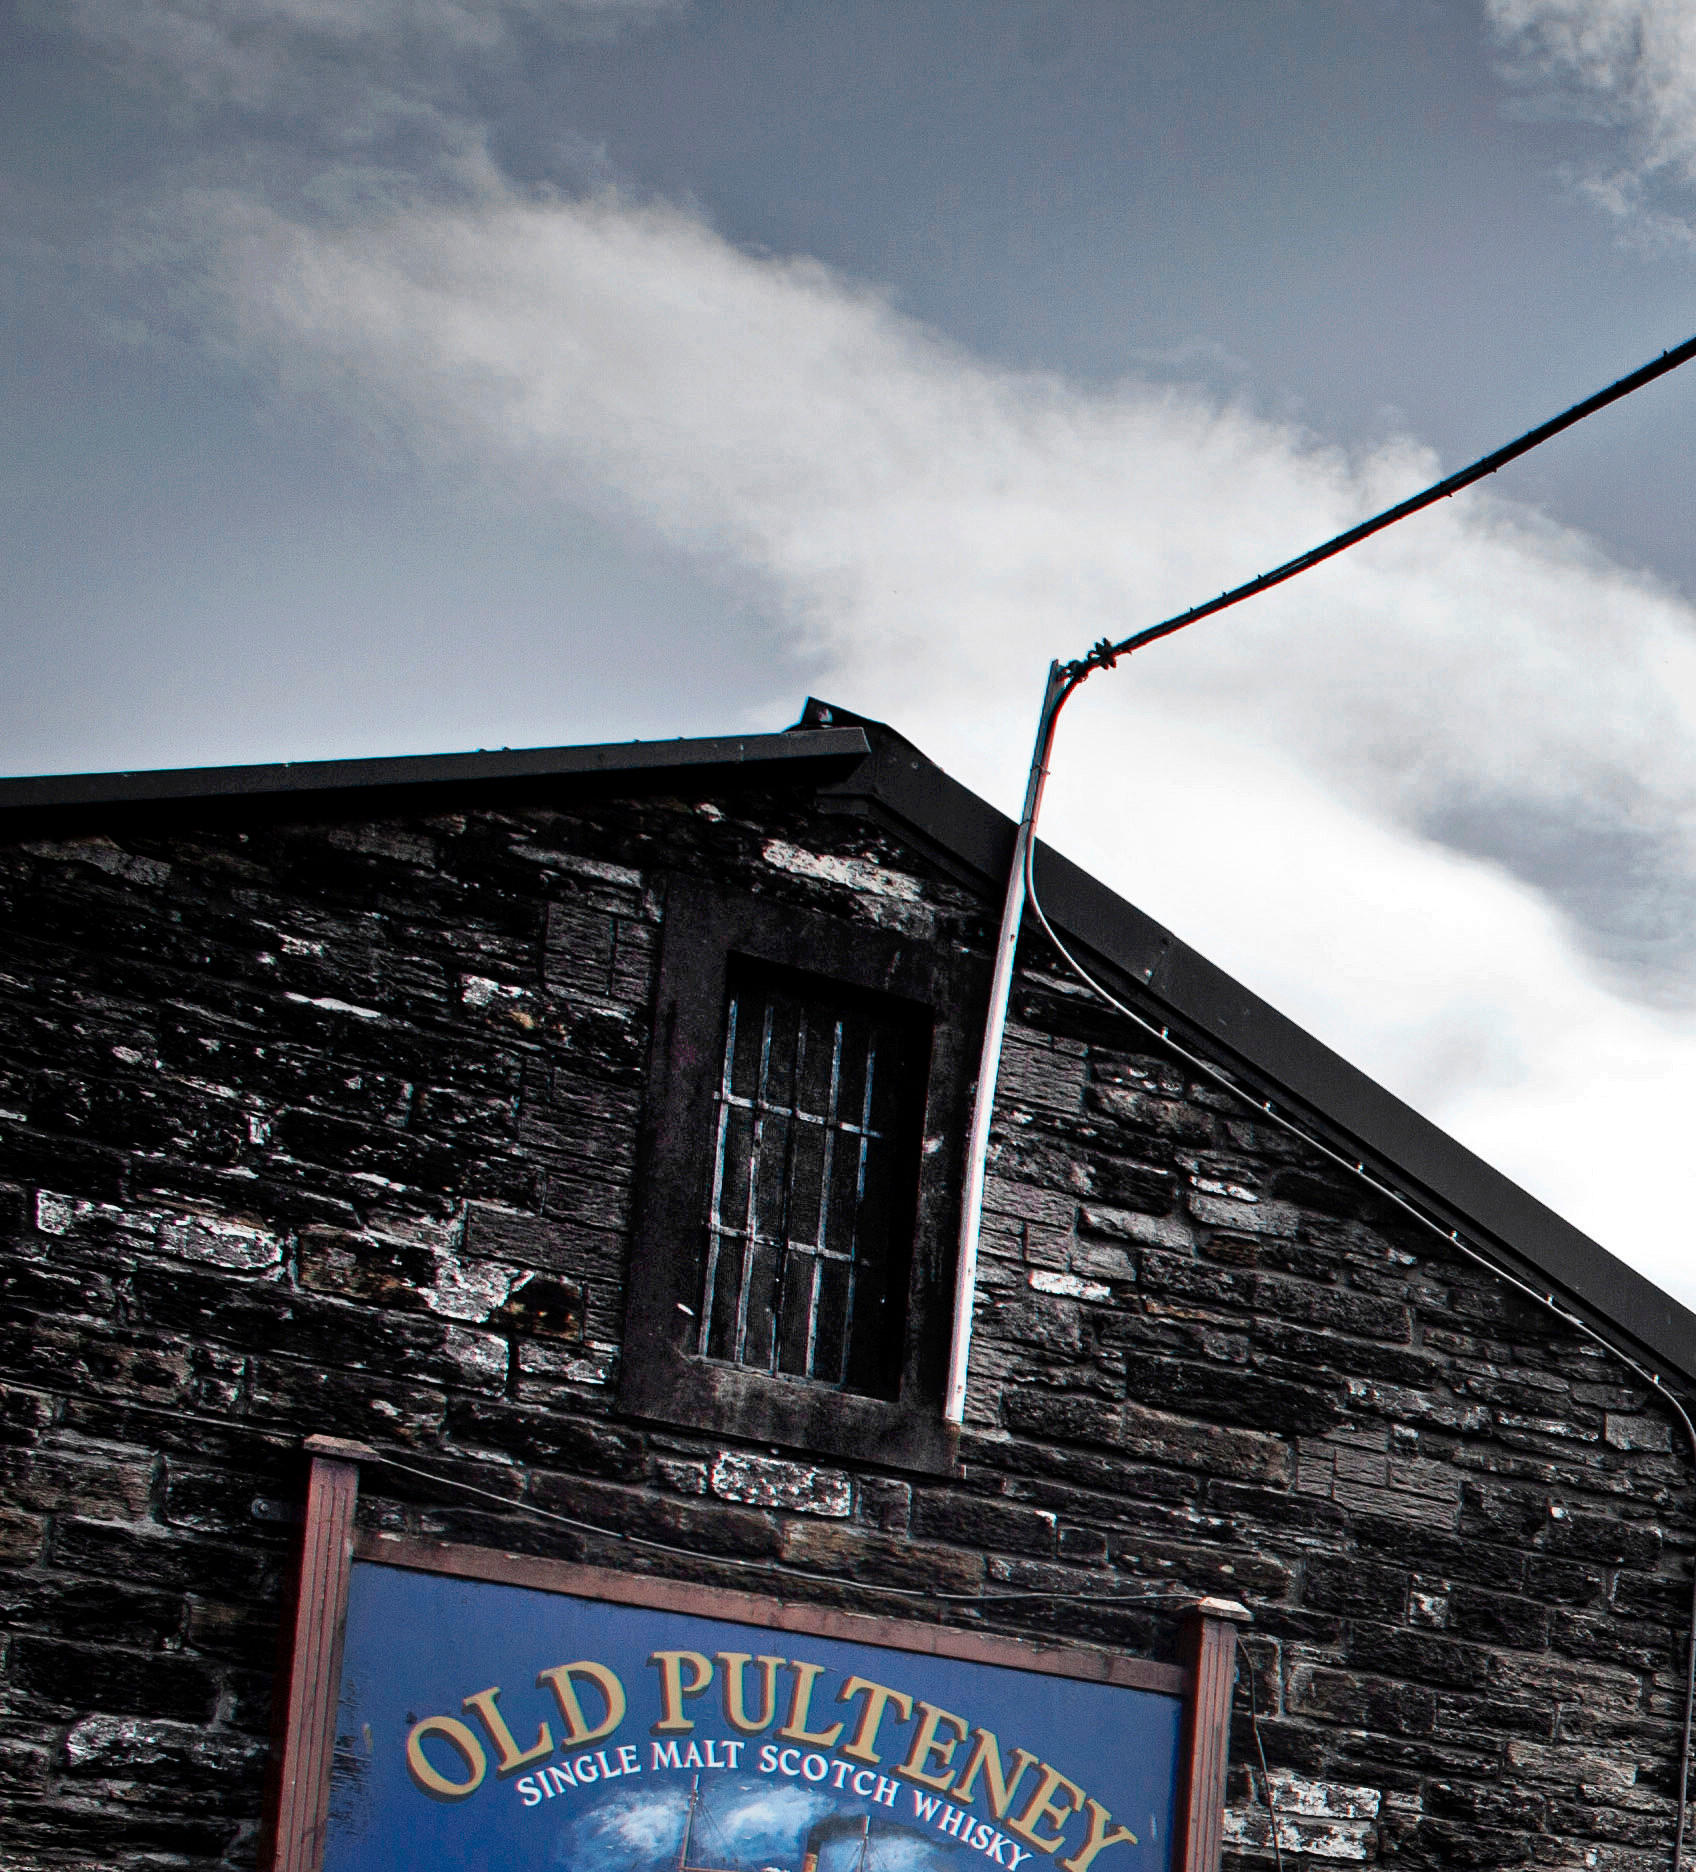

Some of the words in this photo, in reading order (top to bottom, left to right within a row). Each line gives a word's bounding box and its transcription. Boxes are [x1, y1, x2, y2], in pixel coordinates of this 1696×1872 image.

[406, 1660, 627, 1801] OLD
[516, 1745, 642, 1807] SINGLE
[652, 1739, 746, 1771] MALT
[759, 1744, 901, 1807] SCOTCH
[913, 1789, 1033, 1872] WHISKY
